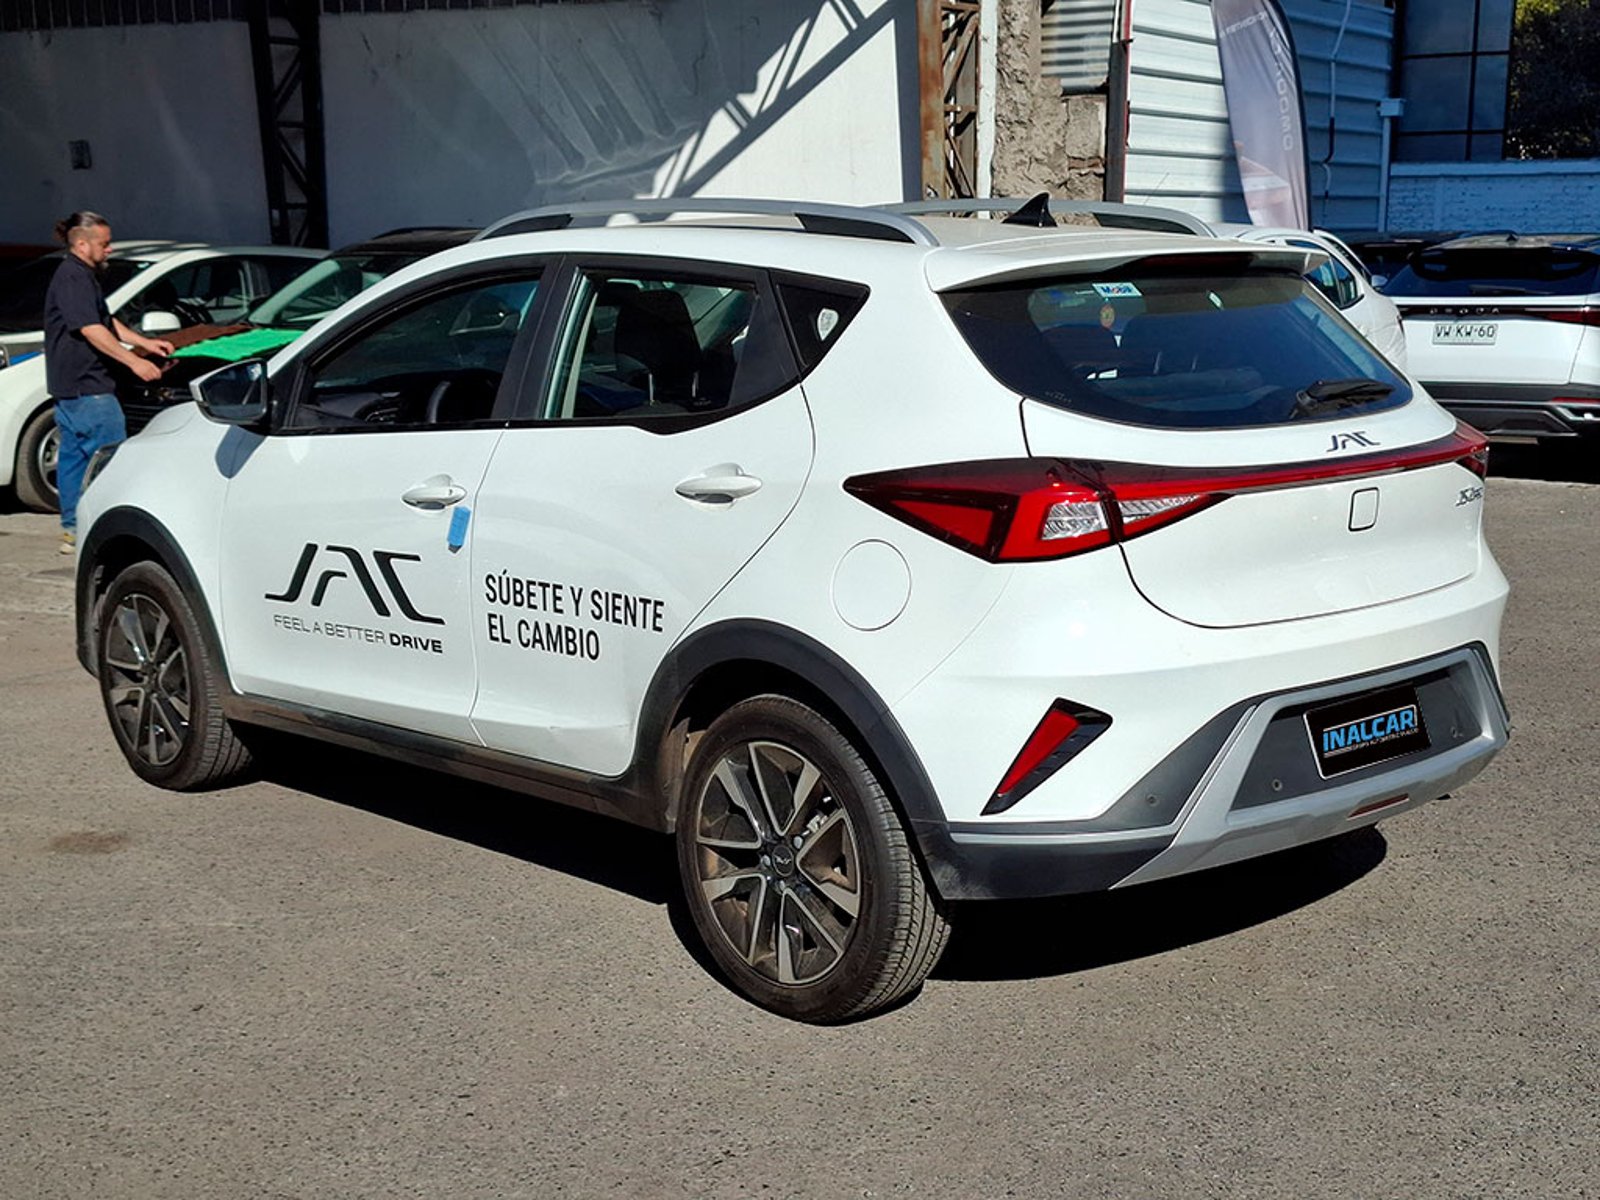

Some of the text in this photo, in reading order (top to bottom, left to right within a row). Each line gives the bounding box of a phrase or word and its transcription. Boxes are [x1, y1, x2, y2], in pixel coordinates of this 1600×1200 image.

[1326, 431, 1381, 453] JAC
[264, 543, 445, 624] JAC
[485, 568, 665, 633] SÚBETE Y SIENTE
[273, 614, 443, 653] FEEL A BETTER DRIVE
[487, 612, 600, 661] EL CAMBIO
